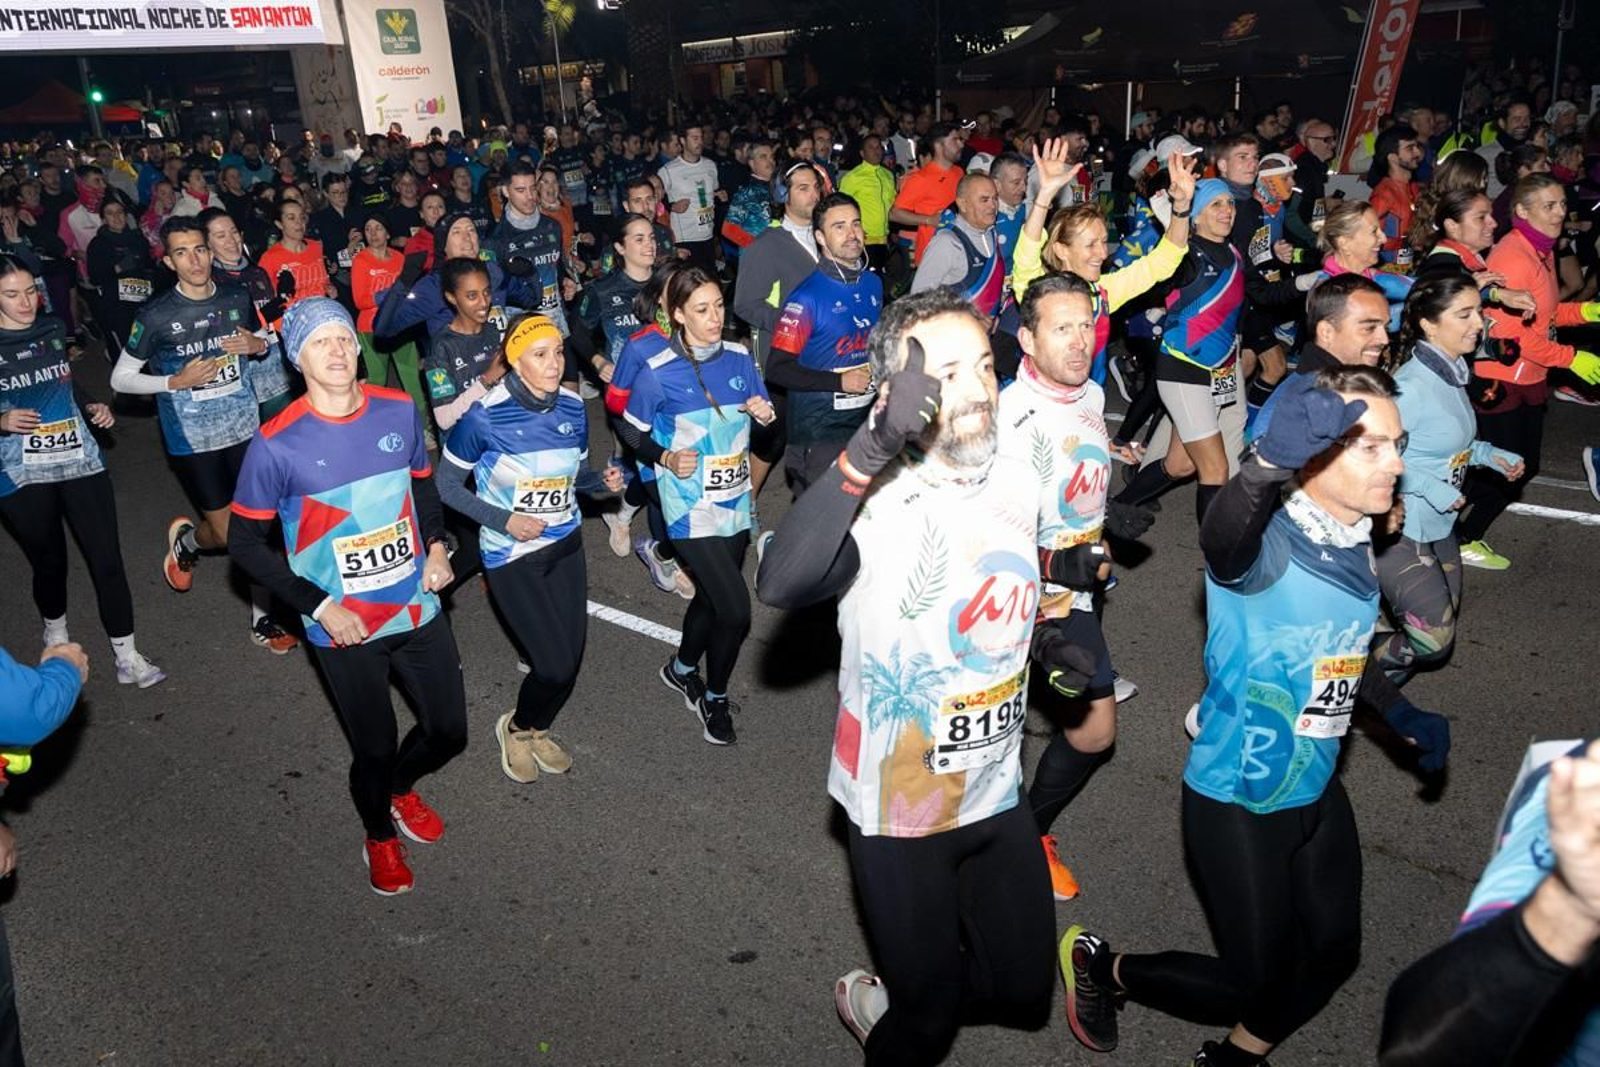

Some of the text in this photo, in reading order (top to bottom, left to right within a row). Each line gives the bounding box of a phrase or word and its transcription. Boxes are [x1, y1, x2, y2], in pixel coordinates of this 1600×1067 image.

[0, 8, 146, 31] NTERNACIONAL
[147, 8, 204, 29] NOCHE
[206, 8, 229, 28] DE
[230, 7, 262, 28] SAN
[176, 341, 204, 357] SAN
[0, 372, 32, 392] SAN
[29, 431, 78, 449] 6344
[710, 459, 749, 485] 5348
[519, 488, 569, 507] 4761
[345, 537, 409, 571] 5108
[948, 691, 1022, 742] 8198
